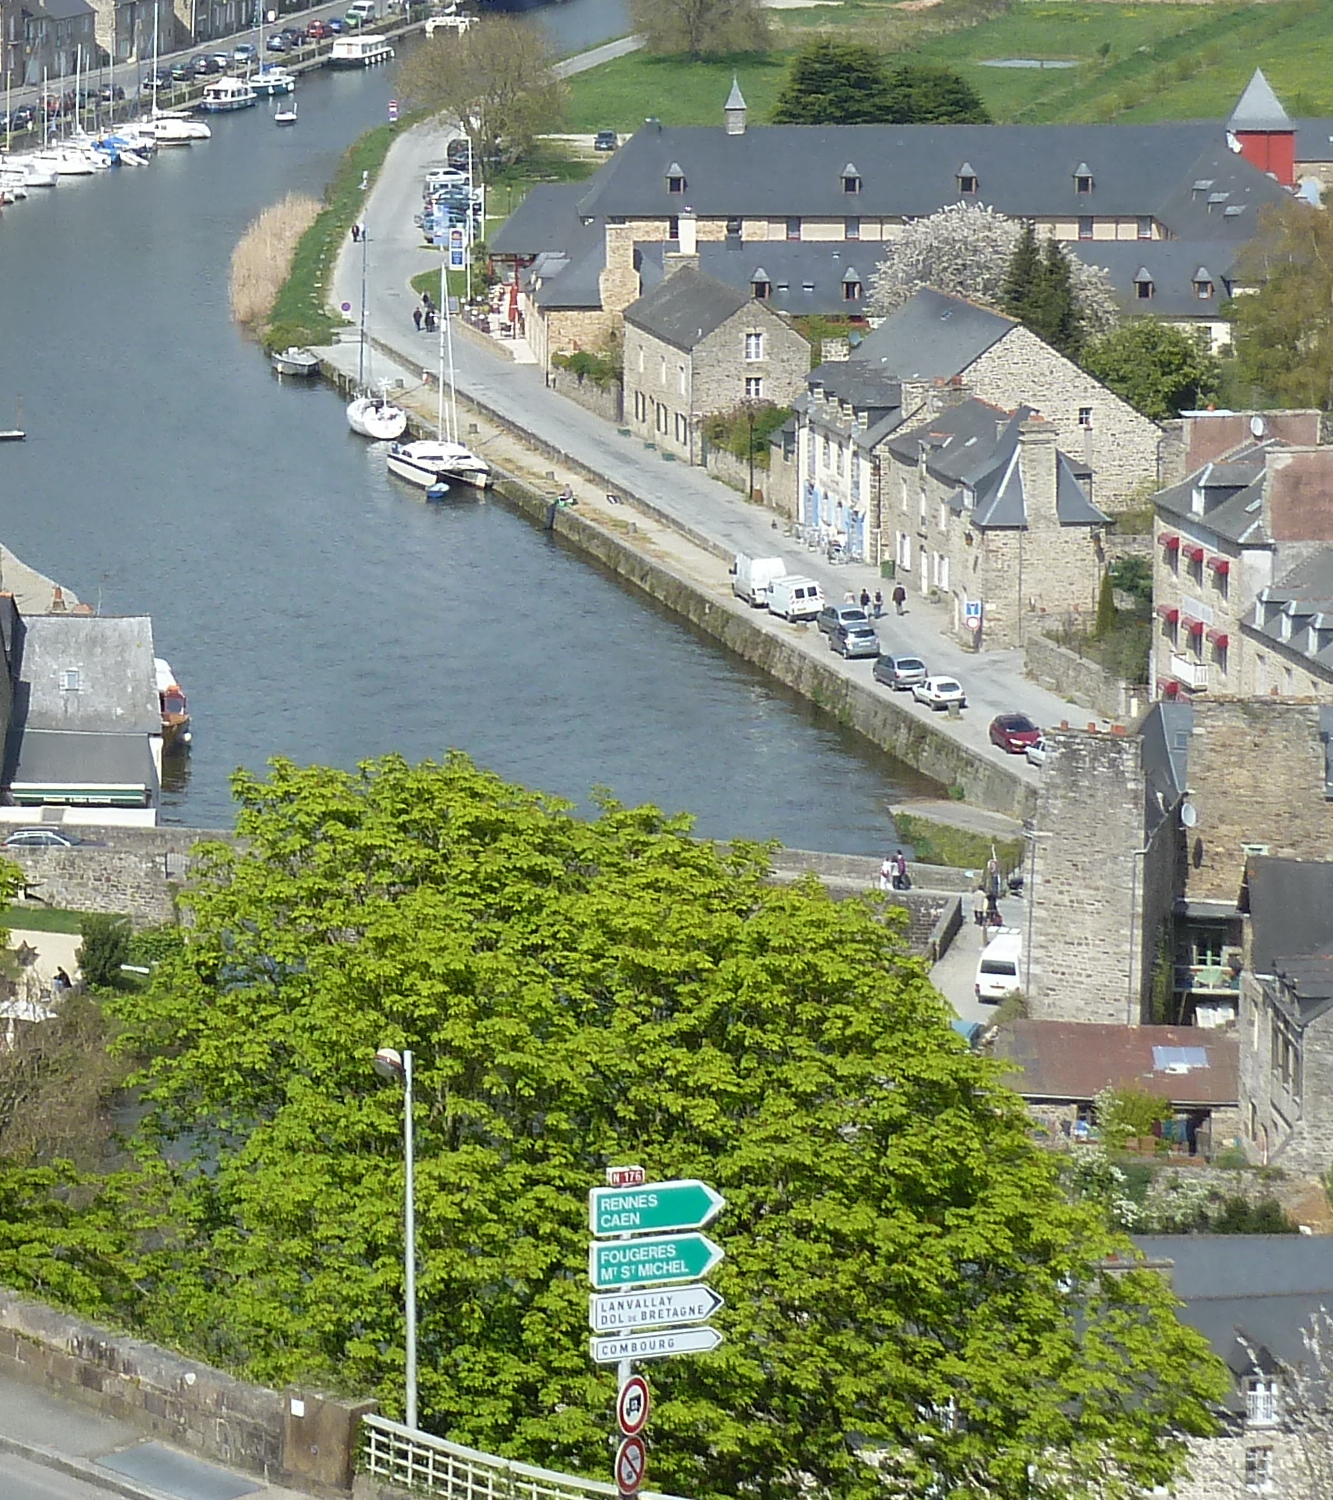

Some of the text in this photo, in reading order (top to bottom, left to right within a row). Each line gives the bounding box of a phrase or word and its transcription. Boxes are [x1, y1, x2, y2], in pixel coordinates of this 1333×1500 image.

[613, 1171, 642, 1183] N 176
[600, 1194, 658, 1211] RENNES
[600, 1212, 640, 1227] CAEN
[600, 1244, 676, 1264] FOUGERES
[638, 1260, 689, 1276] MICHEL
[601, 1295, 673, 1313] LANVALLAY
[601, 1314, 624, 1325] DOL
[641, 1305, 704, 1321] BRETAGNE
[602, 1339, 675, 1355] COMBOURG
